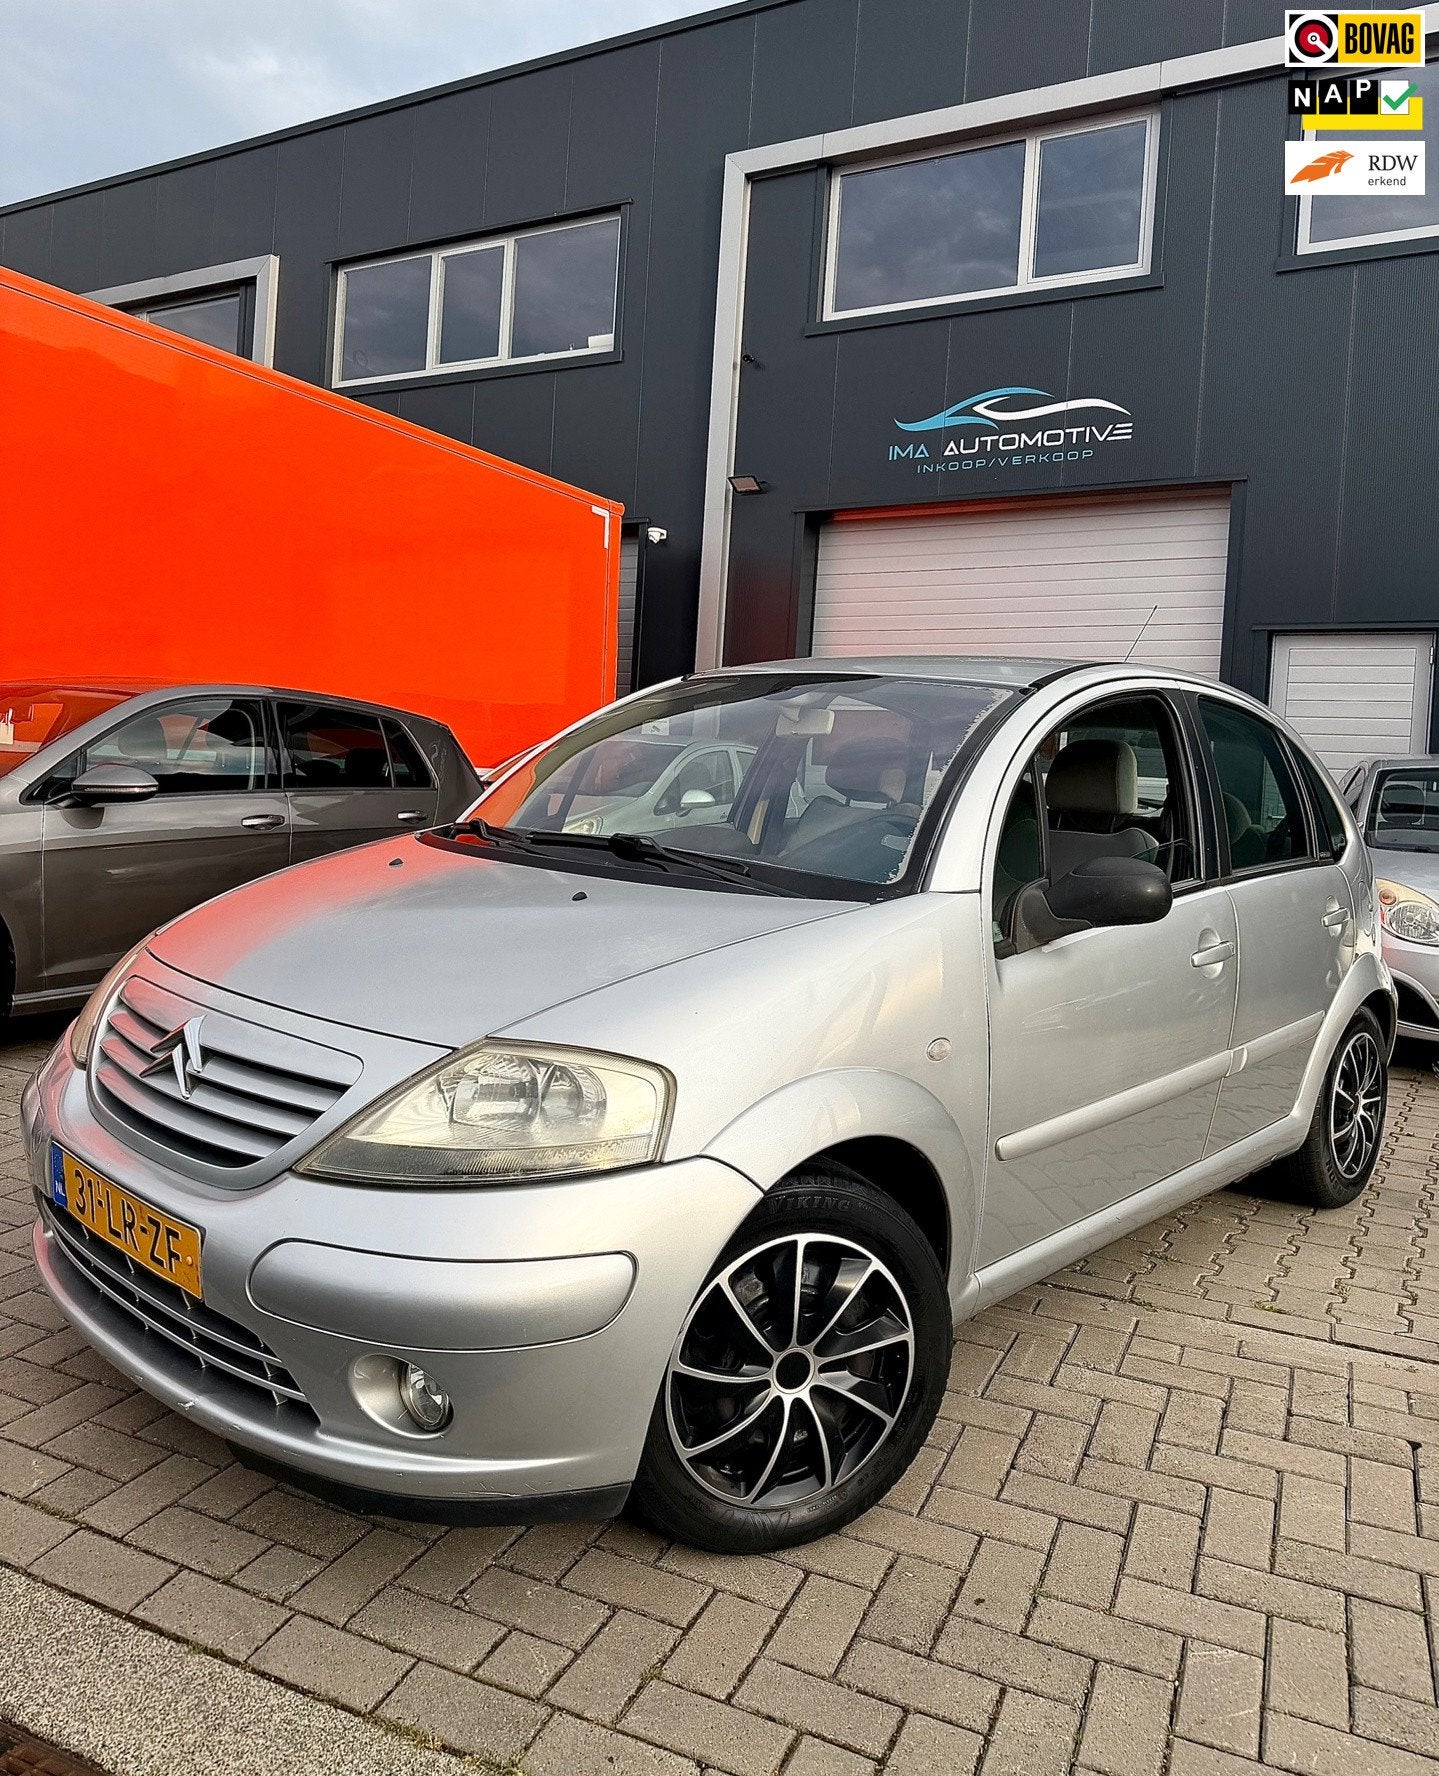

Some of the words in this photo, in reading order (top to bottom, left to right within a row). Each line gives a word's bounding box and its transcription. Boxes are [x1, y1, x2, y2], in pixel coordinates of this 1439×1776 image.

[889, 443, 930, 461] IMA
[943, 422, 1133, 457] AUTOMOTIVE
[917, 449, 1094, 474] INKOOP/VERKOOP
[55, 1180, 67, 1197] NL
[74, 1169, 183, 1275] 31-LR-ZF
